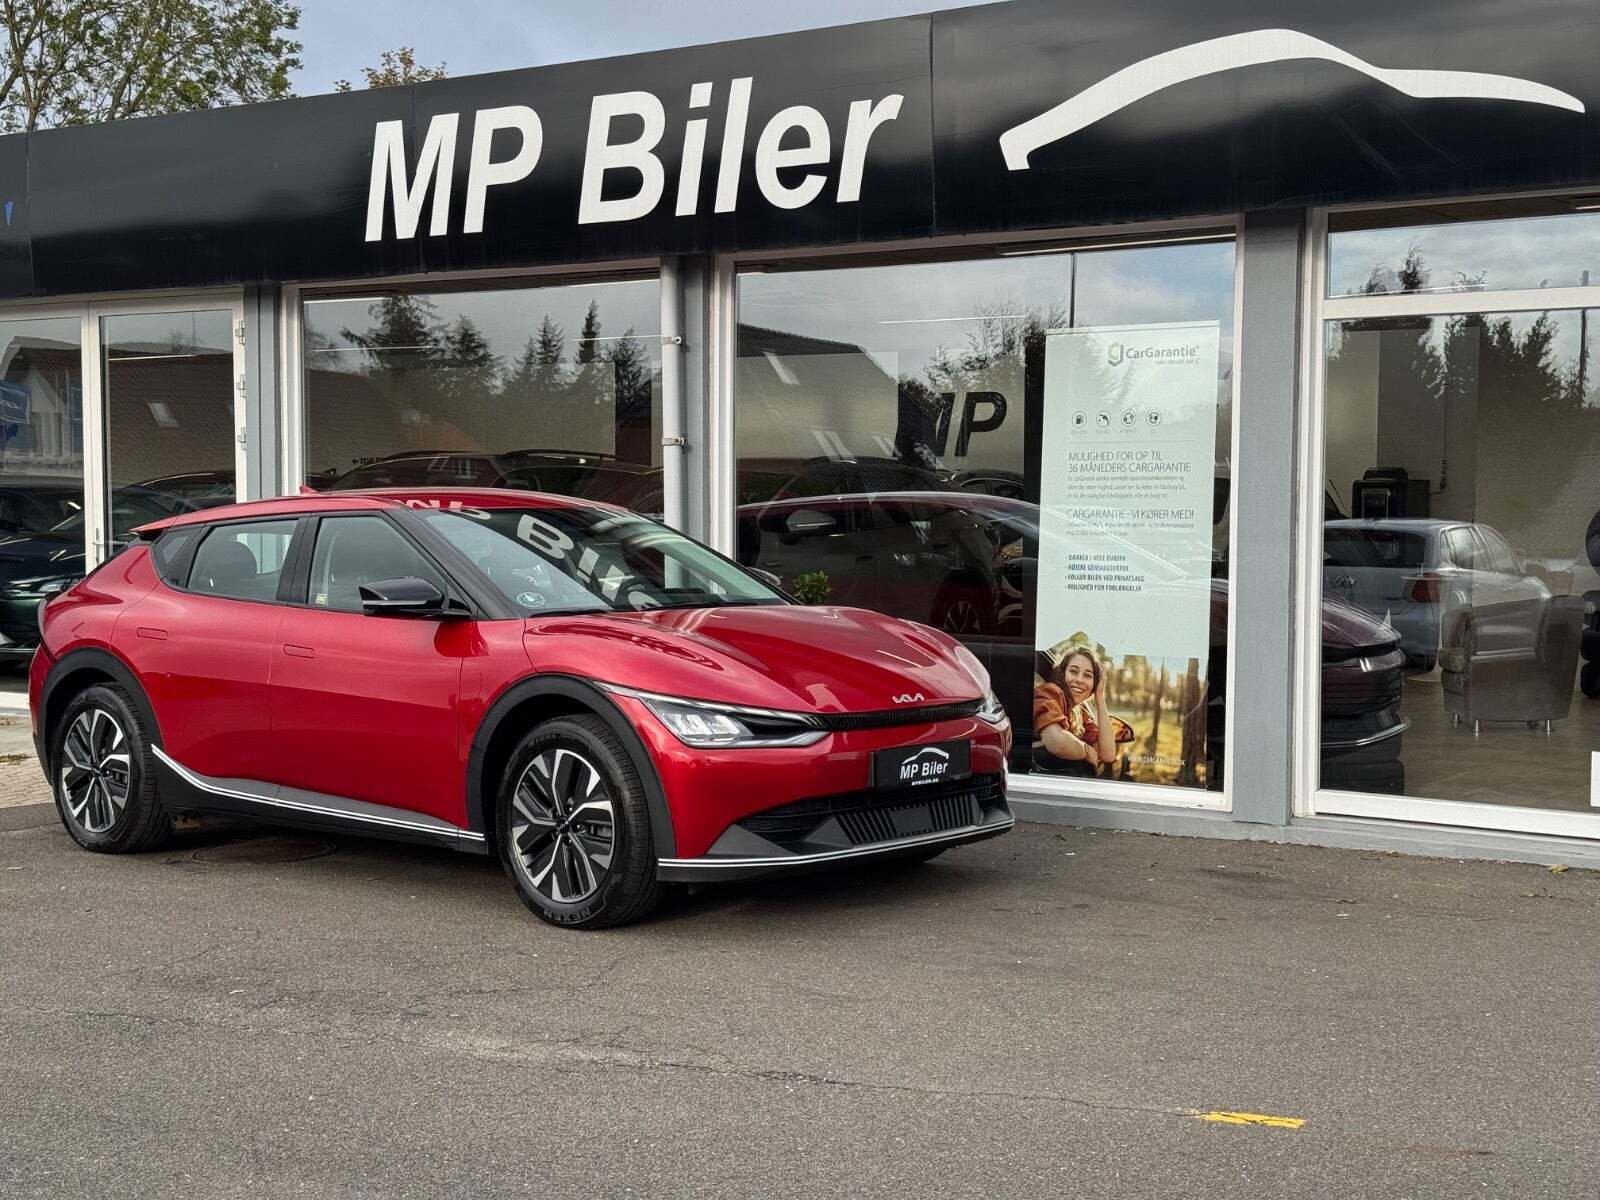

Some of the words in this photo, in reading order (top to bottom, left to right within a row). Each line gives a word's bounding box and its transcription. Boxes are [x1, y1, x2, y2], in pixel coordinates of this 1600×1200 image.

[365, 106, 543, 241] MP
[578, 77, 904, 224] Biler
[1068, 451, 1114, 461] MULIGHED
[1116, 451, 1134, 461] FOR
[1135, 451, 1149, 461] OP
[1151, 451, 1162, 461] TIL
[1068, 463, 1079, 473] 36
[1080, 461, 1127, 473] MÅNEDERS
[1128, 462, 1191, 473] CARGARANTIE
[900, 763, 919, 780] MP
[921, 761, 949, 777] Biler
